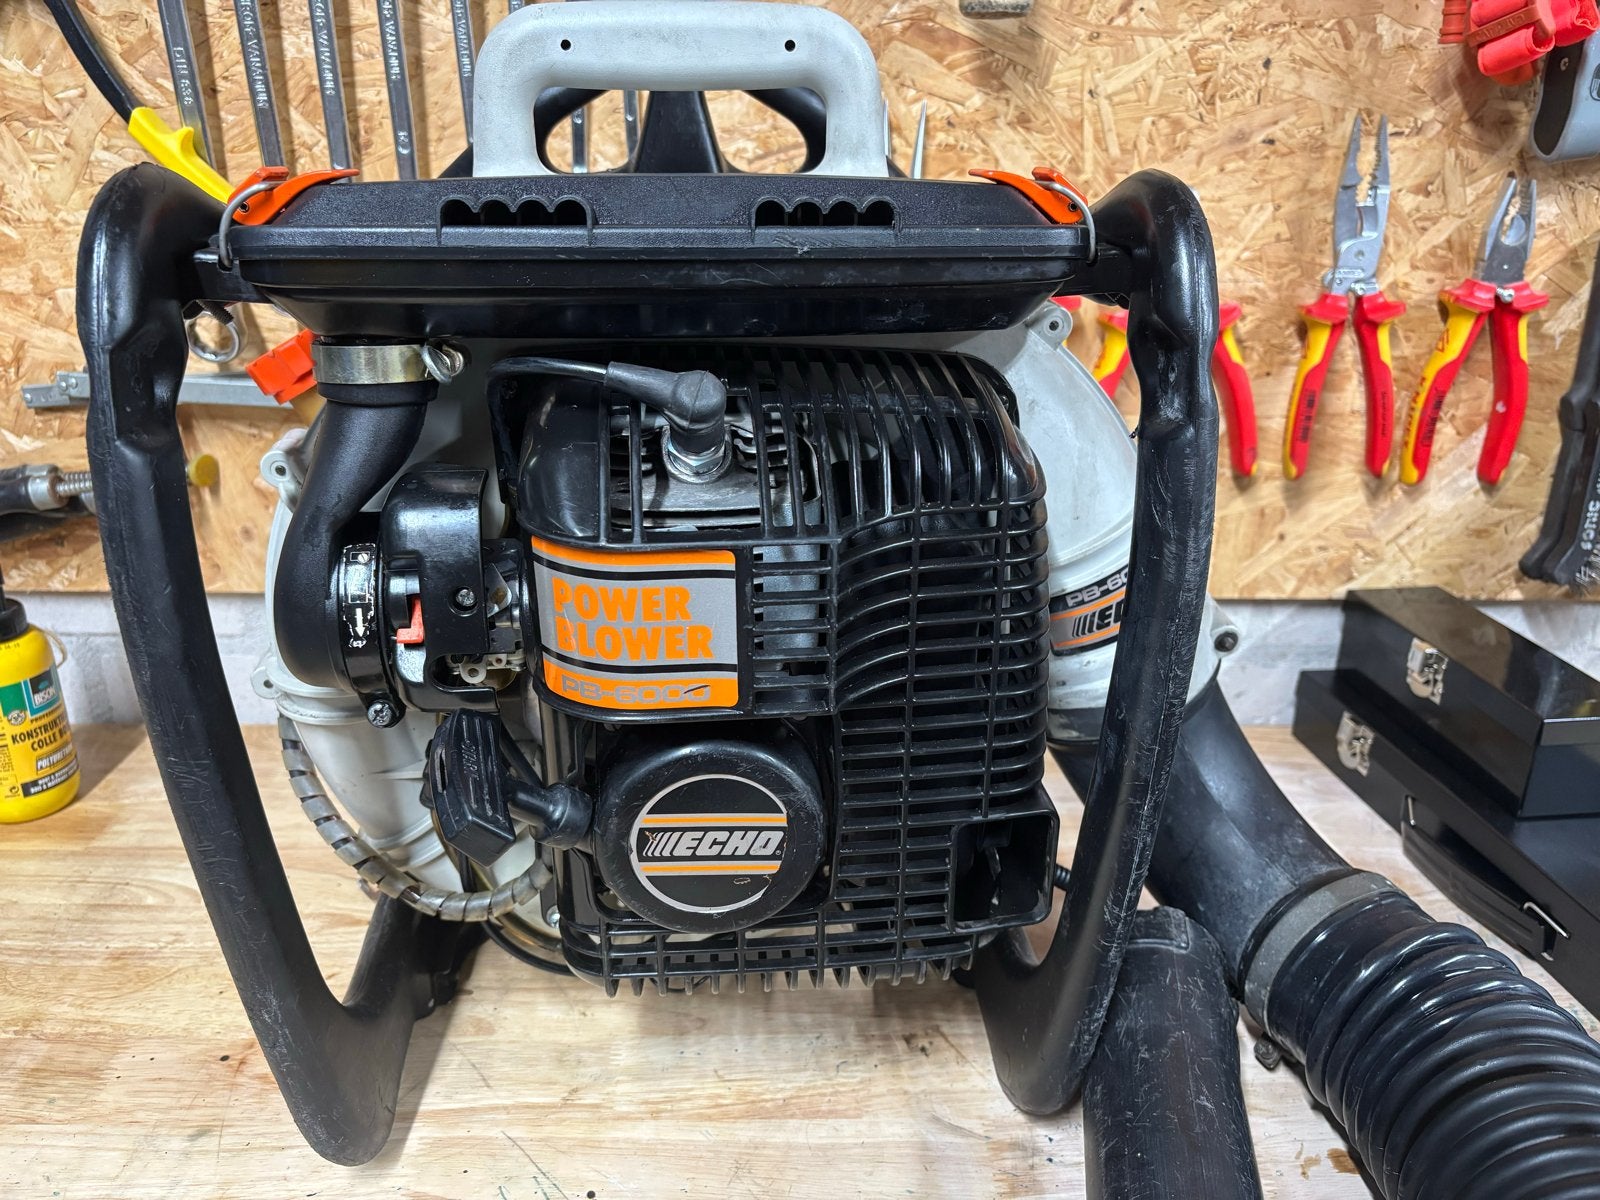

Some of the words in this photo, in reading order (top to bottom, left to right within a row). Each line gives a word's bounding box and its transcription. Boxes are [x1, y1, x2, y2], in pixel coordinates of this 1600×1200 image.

[551, 576, 693, 623] POWER
[554, 616, 715, 661] BLOWER
[33, 686, 56, 706] BISON
[561, 674, 712, 704] PB-6000
[31, 732, 57, 751] COLLE
[668, 830, 785, 857] ECHO
